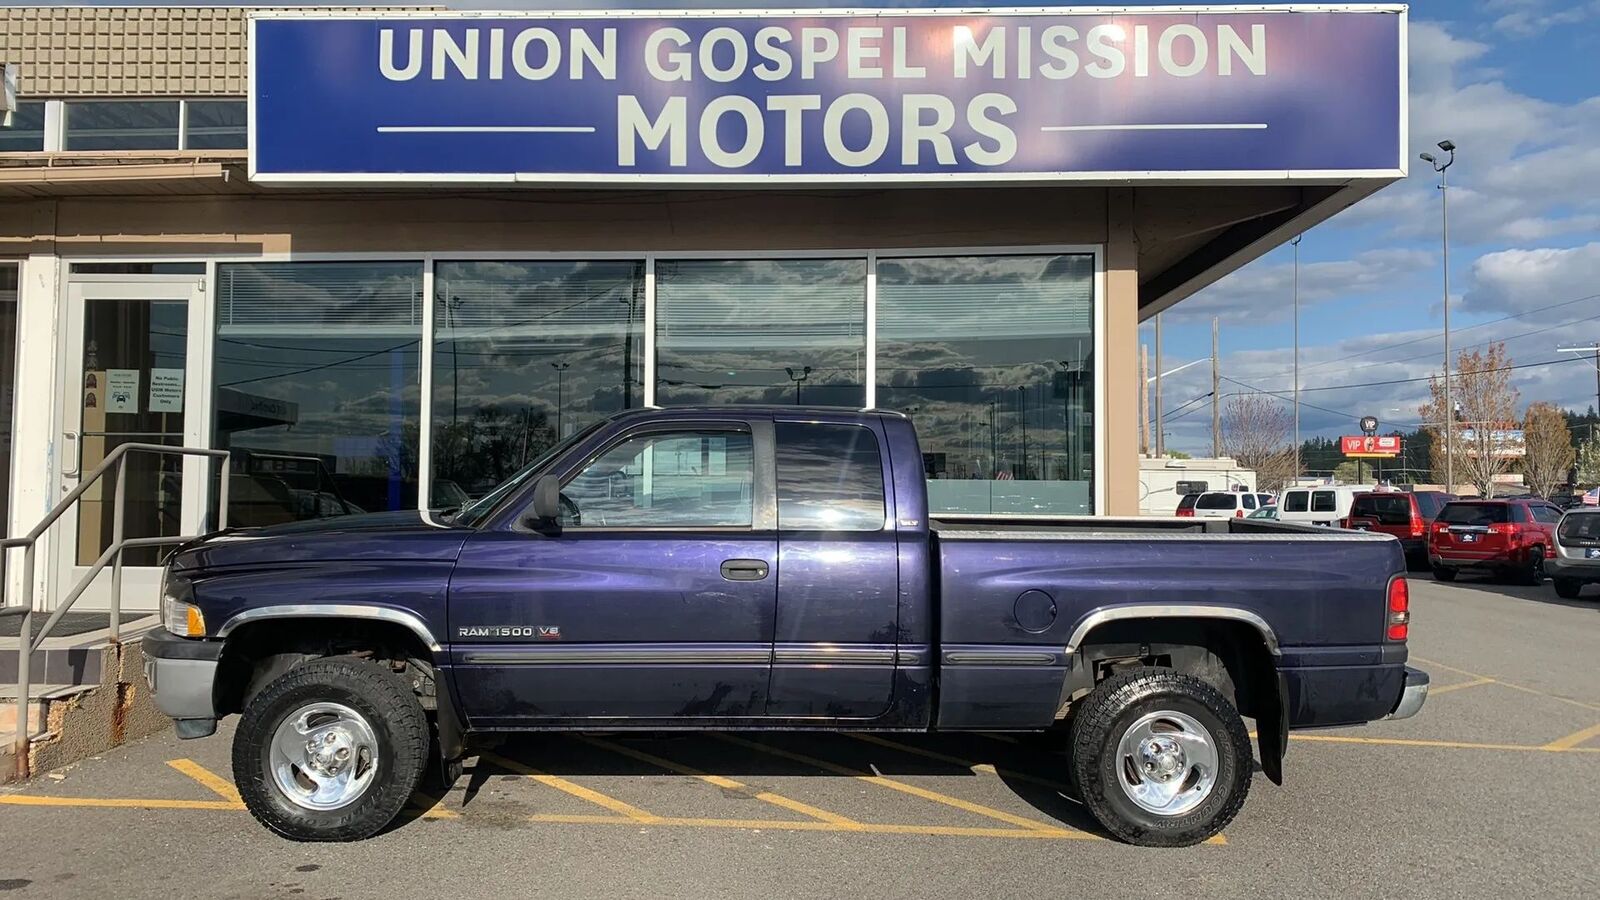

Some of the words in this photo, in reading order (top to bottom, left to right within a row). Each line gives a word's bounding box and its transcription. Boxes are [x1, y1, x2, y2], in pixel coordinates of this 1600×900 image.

[379, 27, 617, 82] UNION
[644, 25, 927, 83] GOSPEL
[952, 23, 1267, 80] MISSION
[617, 92, 1019, 169] MOTORS
[1364, 420, 1376, 428] VIP
[1347, 440, 1361, 451] VIP
[459, 628, 489, 636] RAM
[495, 628, 532, 636] 1500
